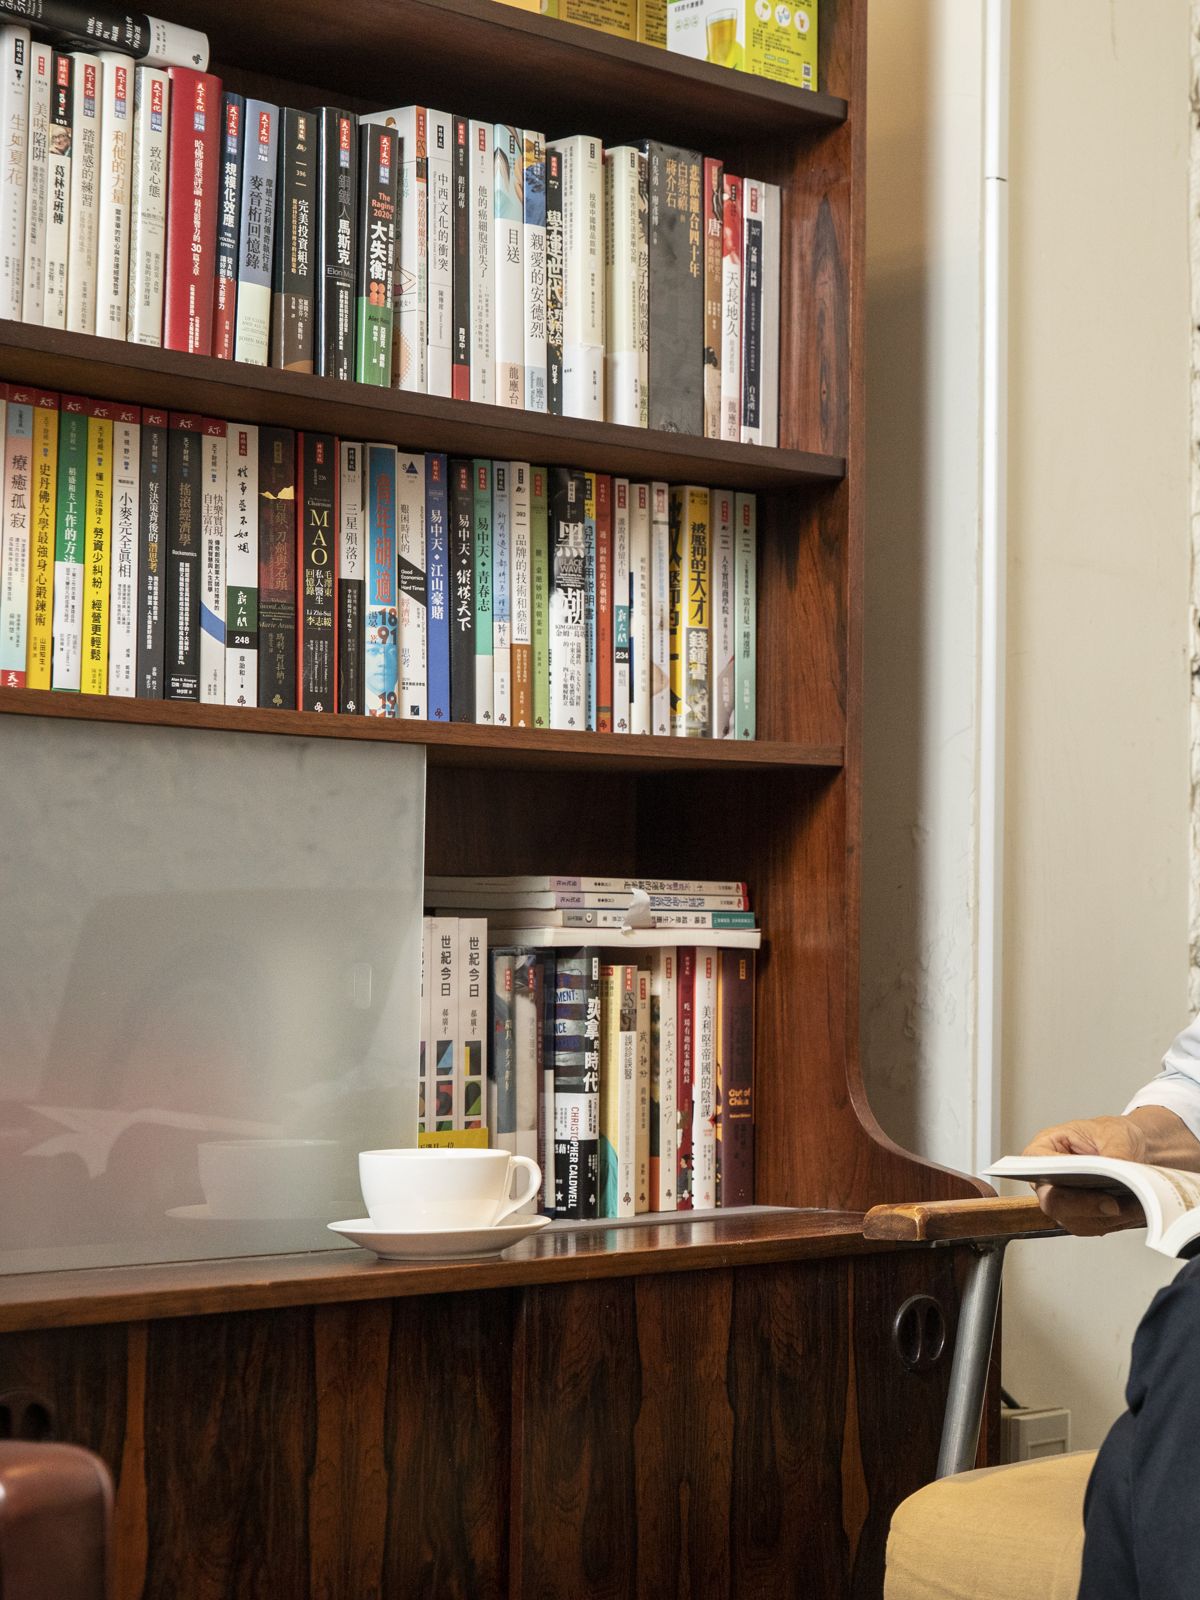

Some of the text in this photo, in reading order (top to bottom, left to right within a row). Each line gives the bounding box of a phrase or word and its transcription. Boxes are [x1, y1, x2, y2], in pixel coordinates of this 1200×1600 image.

[84, 64, 96, 98] 天下文化
[116, 67, 127, 99] 天下文化
[152, 80, 163, 113] 天下文化
[195, 80, 207, 112] 天下文化
[32, 102, 48, 163] 美味陷阱
[228, 105, 239, 136] 天下文化
[259, 112, 271, 144] 天下文化
[340, 118, 350, 150] 天下文化
[7, 113, 25, 187] 生如夏花
[81, 129, 95, 208] 踏實感的練習
[111, 130, 127, 204] 利他的力量
[380, 136, 390, 166] 天下文化
[149, 146, 161, 198] 致富心態
[666, 159, 676, 208] 蔣介石
[53, 165, 66, 225] 葛林史班傳
[223, 162, 237, 227] 規模化效應
[372, 199, 394, 212] Raging
[373, 208, 392, 220] 2020s
[378, 192, 390, 201] The
[245, 176, 263, 269] 麥晉桁回憶錄
[297, 200, 309, 276] 完美投資組合
[437, 173, 449, 272] 中西文化的衝突
[478, 186, 488, 277] 他的癌細胞消失了
[689, 165, 699, 277] 悲歡離合四十年
[370, 221, 387, 280] 大失衡
[506, 229, 520, 264] 目送
[327, 268, 342, 276] Elon
[530, 232, 544, 339] 親愛的安德烈
[726, 271, 738, 338] 天長地久
[14, 393, 29, 402] 天下
[40, 398, 54, 407] 天下
[67, 402, 81, 412] 天下
[509, 367, 519, 405] 龍應台
[535, 377, 544, 410] 龍應台
[93, 408, 109, 417] 天下
[120, 412, 135, 421] 天下
[148, 415, 163, 424] 天下
[179, 419, 193, 429] 天下
[208, 426, 222, 434] 天下
[728, 402, 737, 437] 龍應台
[10, 455, 28, 529] 療癒孤寂
[95, 472, 105, 524] 懂一點法律2
[179, 483, 192, 546] 搖滾經濟學
[204, 493, 213, 536] 自主富有
[213, 494, 223, 537] 快樂實現
[400, 504, 410, 554] 艱困時代的
[35, 464, 50, 627] 史丹佛大學最強身心鍛鍊術
[275, 503, 288, 591] 白銀、刀劍與石頭
[309, 508, 329, 566] MAO
[345, 504, 358, 573] 三星殞落？
[306, 569, 314, 596] 回憶錄
[324, 571, 332, 597] 毛澤東
[430, 509, 445, 620] 易中天 江山豪賭
[456, 514, 472, 631] 易中天 縱橫天下
[477, 517, 491, 612] 易中天 青春志
[515, 534, 527, 635] 品牌的技術和藝術
[560, 559, 583, 567] BLACK
[561, 565, 583, 573] WAVE
[691, 522, 706, 624] 被壓抑的天才
[90, 528, 104, 660] 勞資少糾紛，經營更輕鬆
[315, 569, 323, 605] 私人醫生
[721, 556, 729, 615] 人生實用商學院
[237, 591, 248, 628] 新人間
[306, 615, 331, 627] 李志綏
[235, 636, 250, 645] 248
[401, 648, 410, 668] 思考
[440, 935, 451, 996] 世紀今日
[469, 936, 479, 998] 世紀今日
[701, 1005, 713, 1117] 美利堅帝國的陰謀
[728, 1088, 751, 1098] Out of
[568, 1106, 579, 1208] CHRISTOPHER CALDWELL
